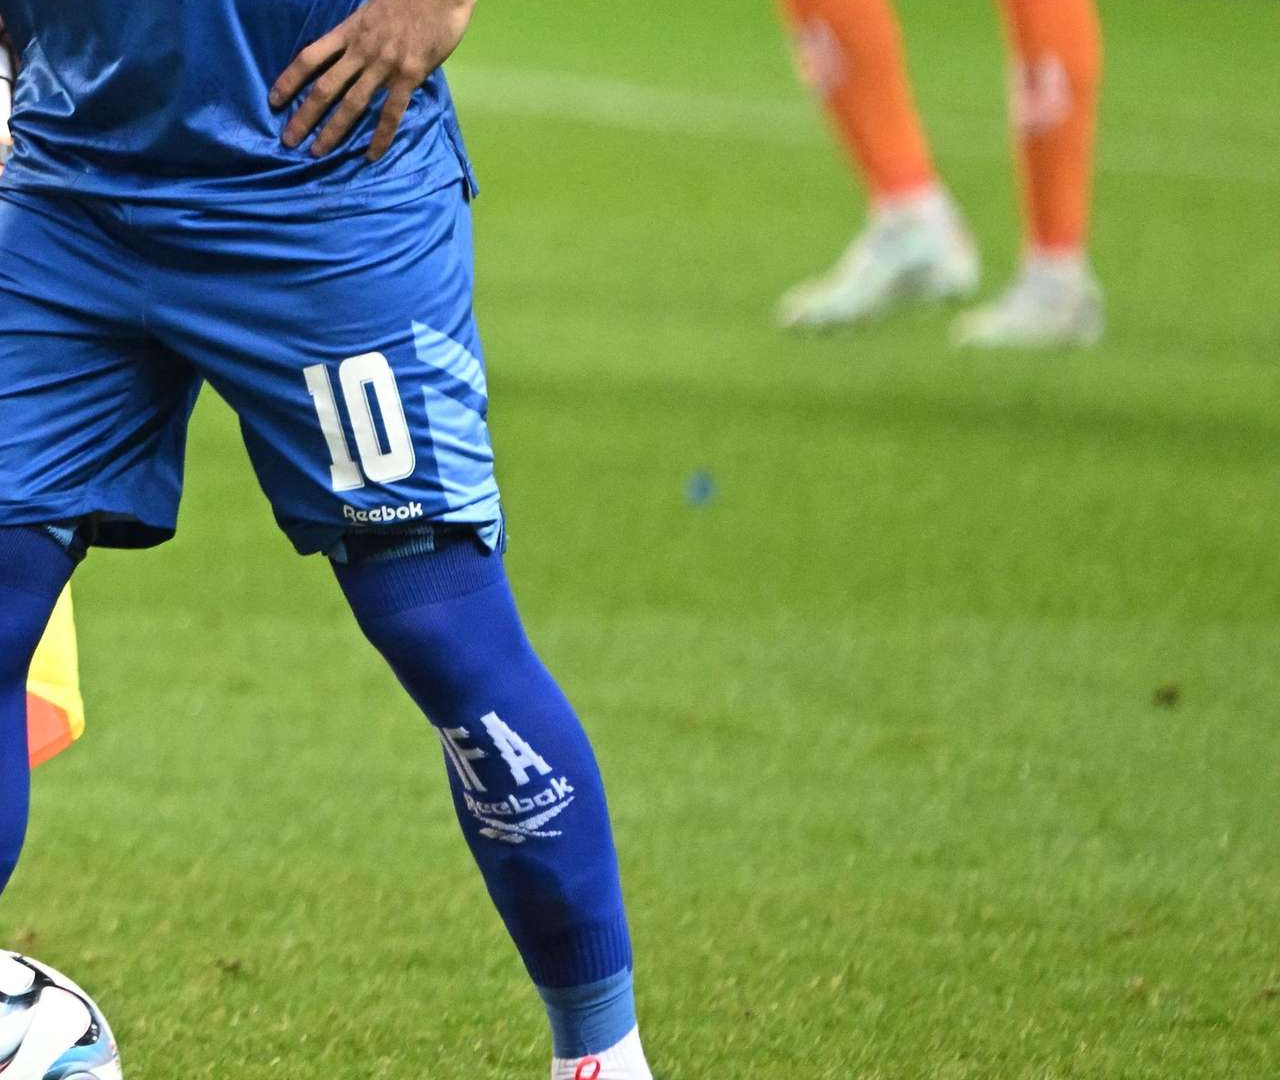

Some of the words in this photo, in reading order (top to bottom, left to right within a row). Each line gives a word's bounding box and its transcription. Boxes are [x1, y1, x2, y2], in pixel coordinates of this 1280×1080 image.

[303, 351, 416, 492] 10
[343, 501, 423, 522] Reebok
[463, 776, 575, 818] Reebok
